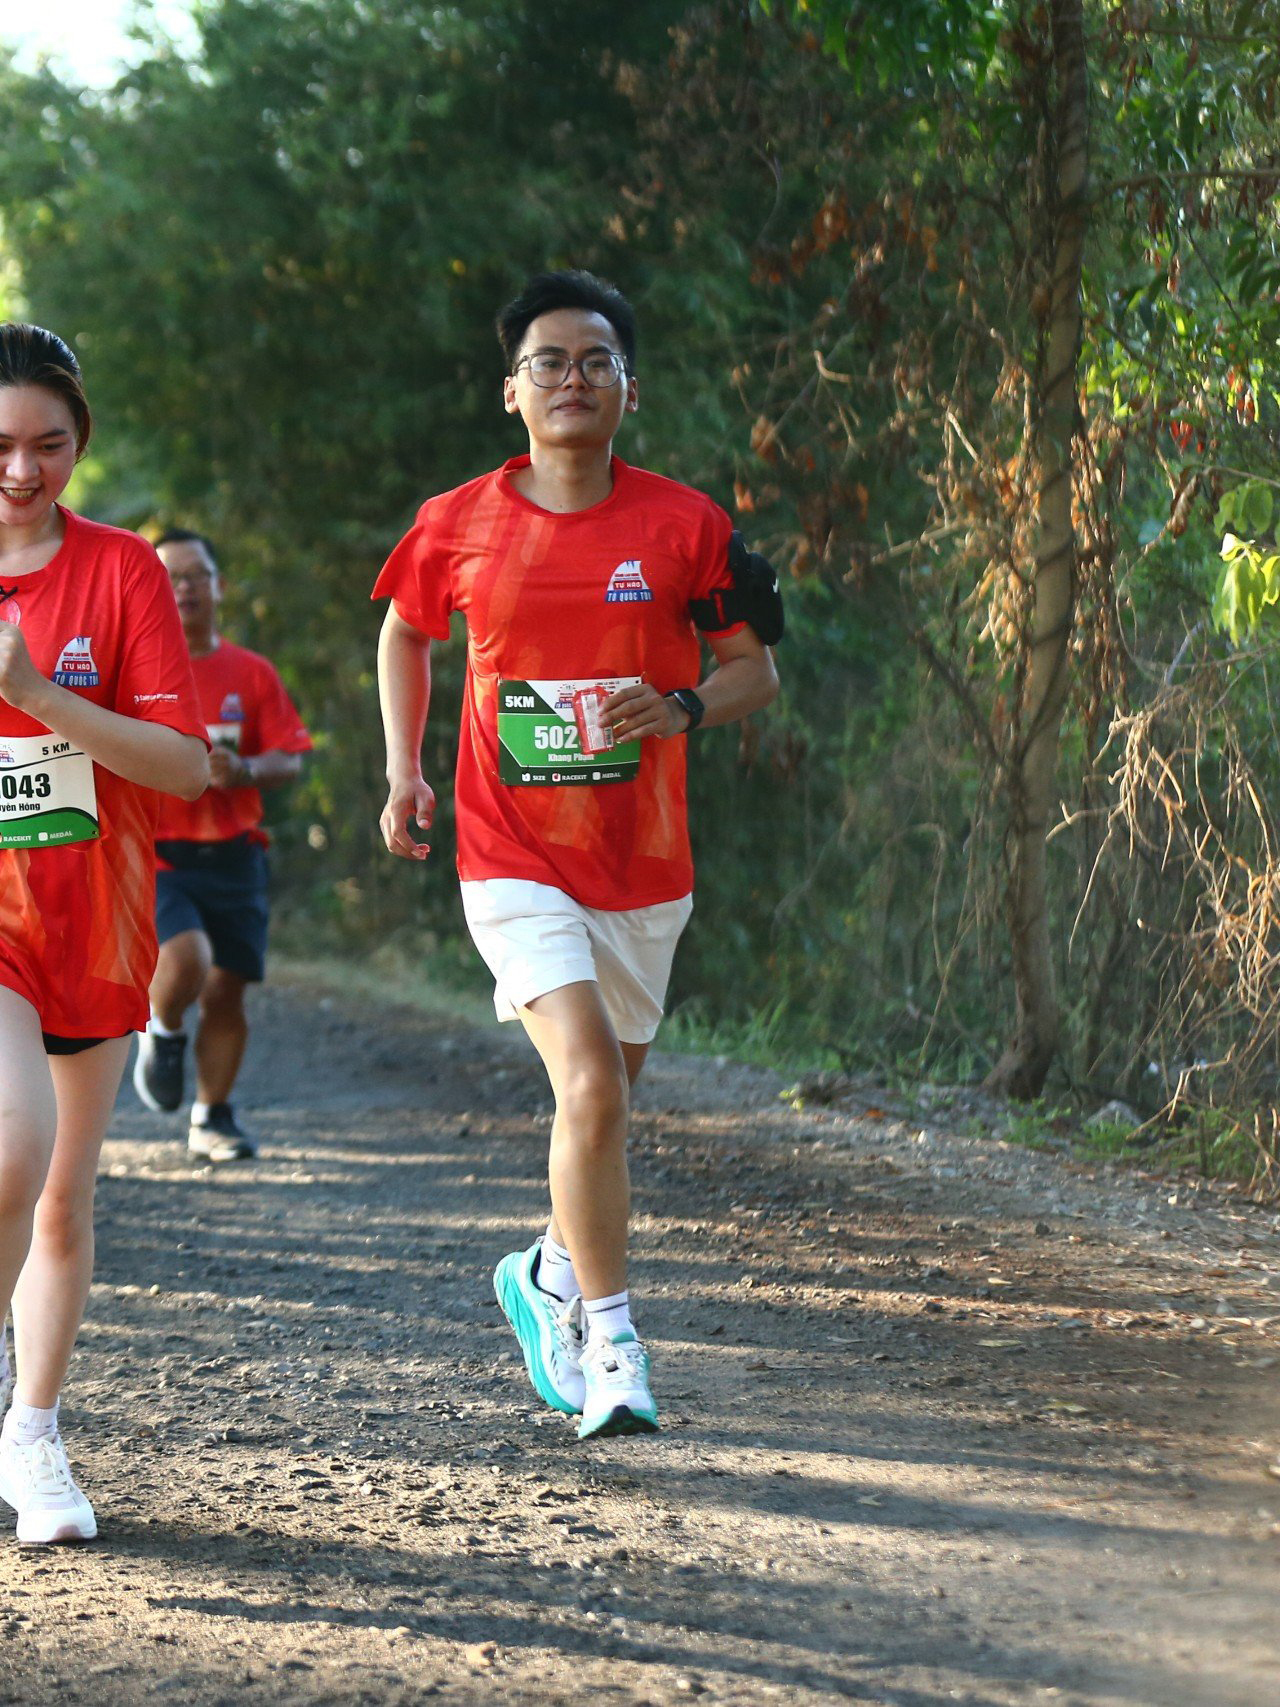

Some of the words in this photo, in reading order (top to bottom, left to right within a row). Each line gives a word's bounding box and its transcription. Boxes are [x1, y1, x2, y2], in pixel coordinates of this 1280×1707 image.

[505, 695, 535, 708] 5KM
[42, 746, 49, 756] 5
[53, 741, 70, 755] KM
[547, 753, 572, 763] Khang
[601, 772, 622, 780] MEDAL
[3, 834, 32, 843] RACEKIT
[49, 831, 73, 841] MEDAL
